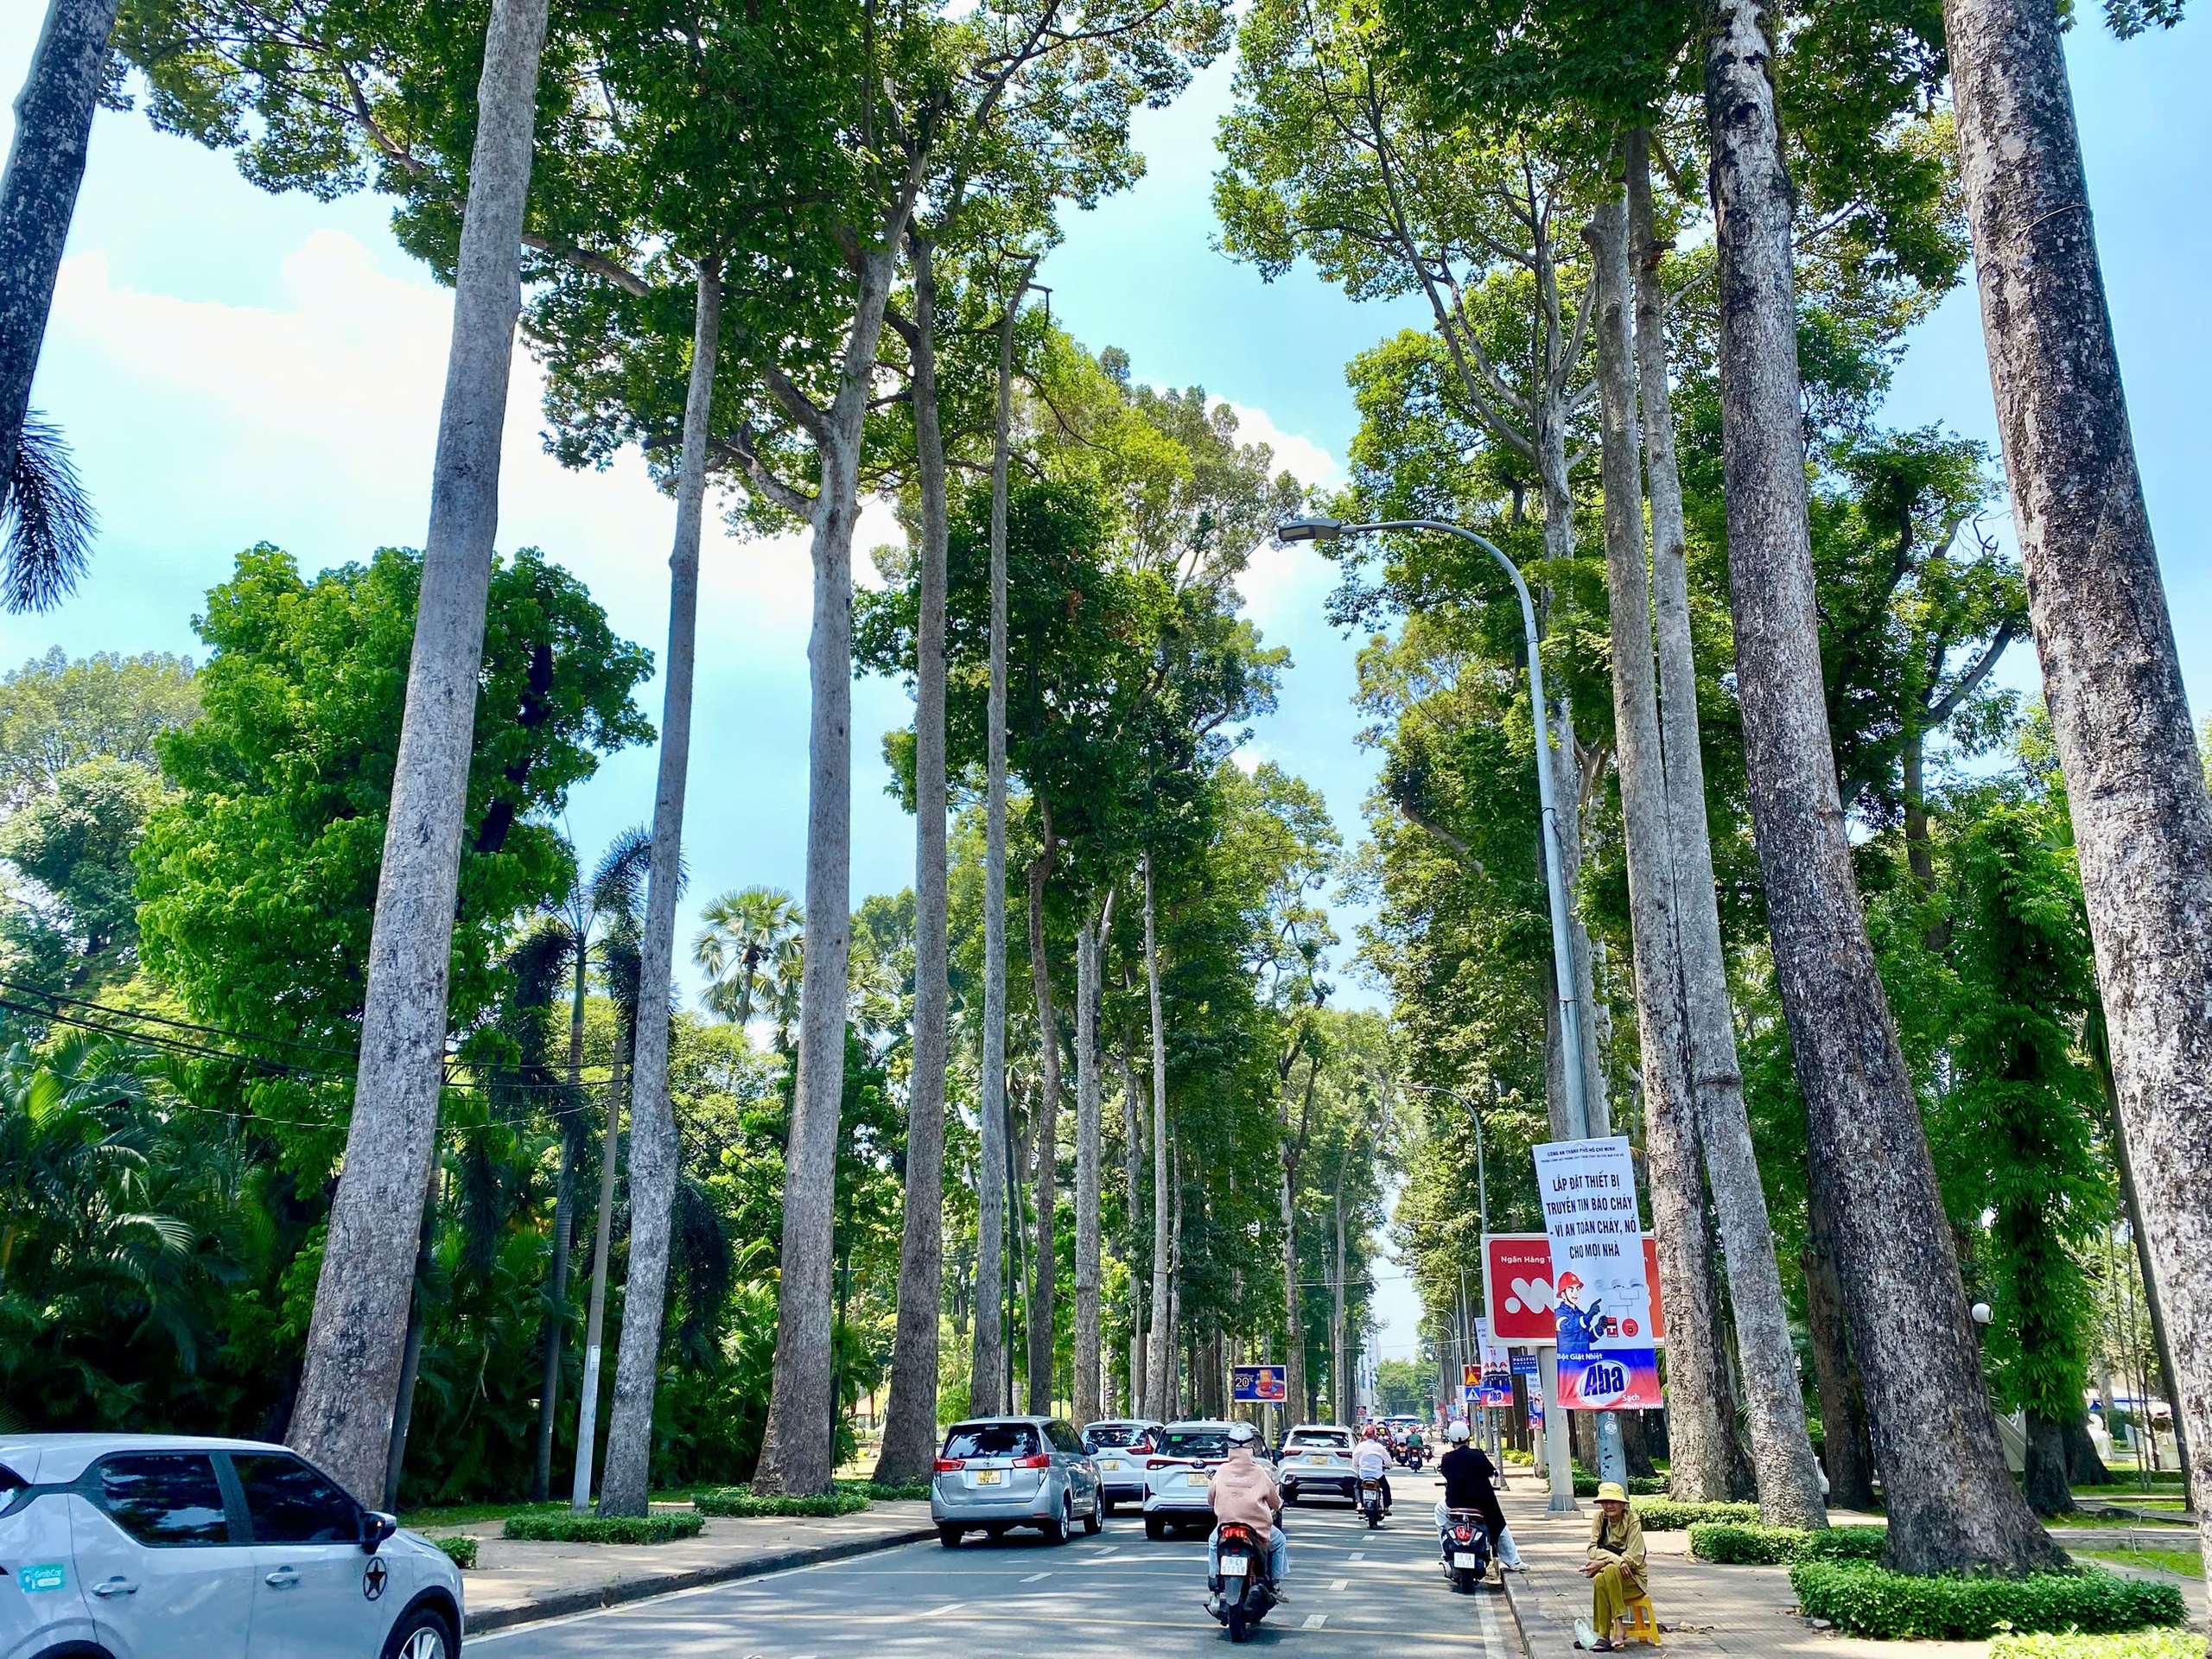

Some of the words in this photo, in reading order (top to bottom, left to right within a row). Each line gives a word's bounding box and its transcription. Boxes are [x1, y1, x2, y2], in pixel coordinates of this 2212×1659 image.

[1585, 1170, 1608, 1188] THIẾT
[1611, 1174, 1620, 1190] BỊ
[1577, 1198, 1589, 1211] TIN
[1592, 1195, 1608, 1211] BÁO
[1611, 1193, 1632, 1211] CHÁY
[1554, 1221, 1564, 1237] VÌ
[1565, 1223, 1576, 1236] AN
[1576, 1218, 1596, 1235] TOÀN
[1597, 1217, 1623, 1236] CHÁY,
[1624, 1214, 1637, 1233] NỔ
[1569, 1245, 1584, 1259] CHO
[1585, 1243, 1601, 1260] MỌI
[1603, 1240, 1620, 1257] NHÀ
[1500, 1255, 1522, 1264] Ngân
[1523, 1255, 1545, 1264] Hàng
[1556, 1352, 1569, 1362] Bột
[1584, 1364, 1625, 1397] Aba
[1489, 1391, 1502, 1402] Aba
[1622, 1393, 1640, 1402] Sạch
